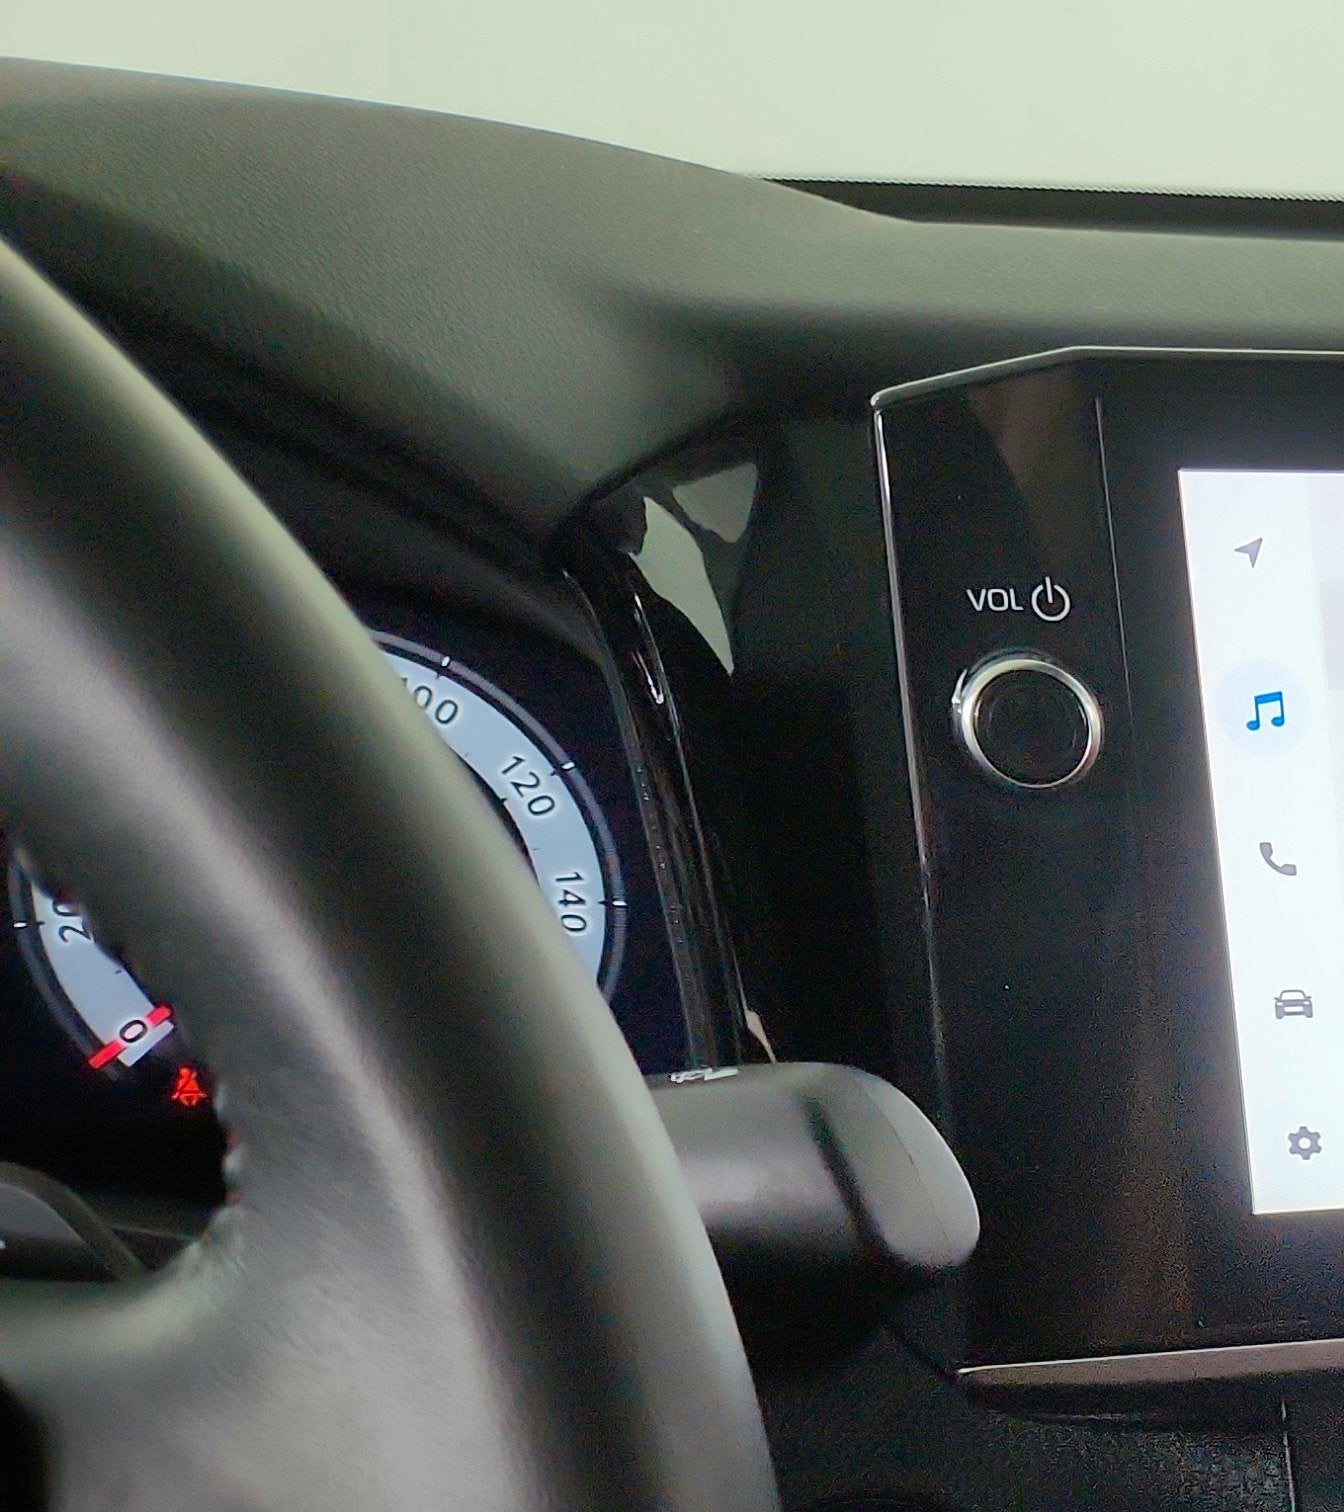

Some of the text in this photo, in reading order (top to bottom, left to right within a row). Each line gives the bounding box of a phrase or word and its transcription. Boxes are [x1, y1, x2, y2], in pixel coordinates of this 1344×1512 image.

[966, 587, 1024, 612] VOL
[499, 755, 556, 817] 120
[554, 871, 587, 932] 140
[119, 1019, 147, 1043] 0
